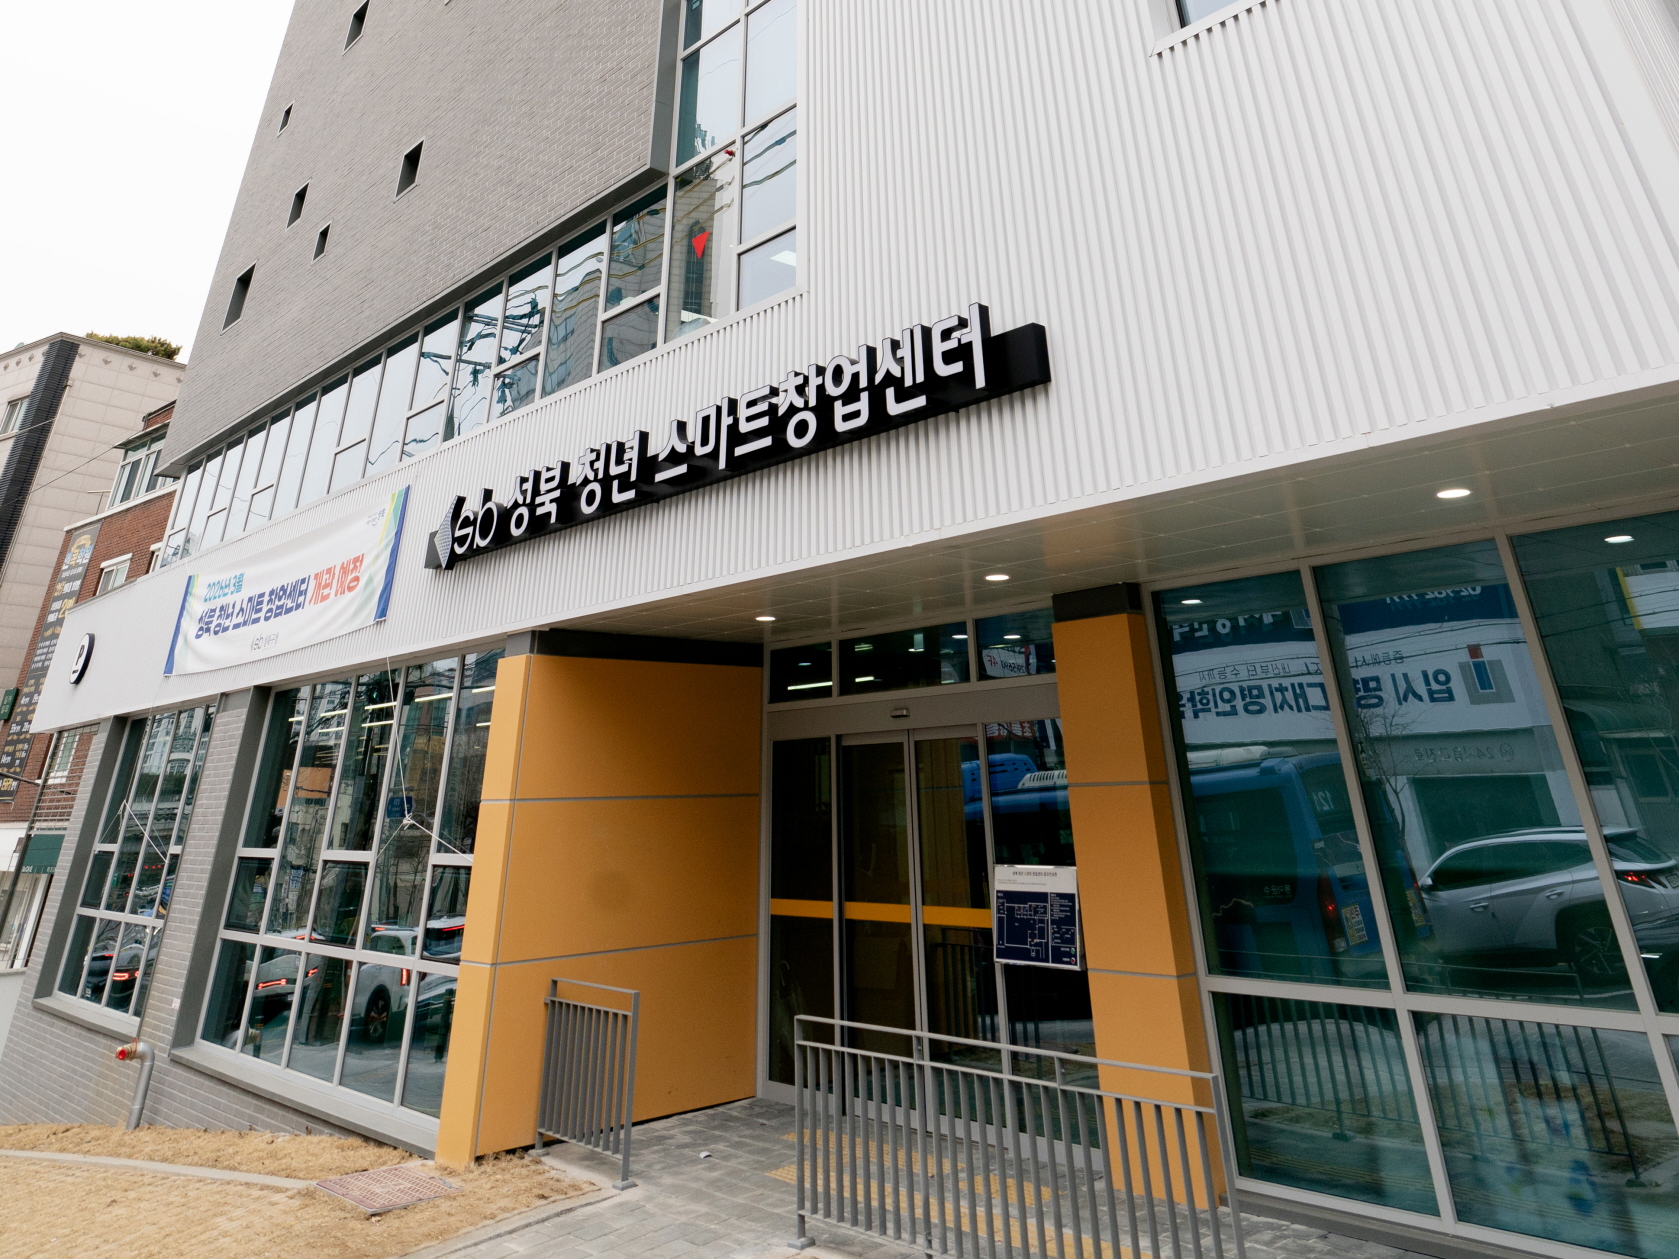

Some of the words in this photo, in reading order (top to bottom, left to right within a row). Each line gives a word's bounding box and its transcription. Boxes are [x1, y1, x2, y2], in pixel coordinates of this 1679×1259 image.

[506, 460, 571, 538] 성북
[574, 430, 650, 516] 청년
[195, 607, 217, 640] 성북
[213, 600, 237, 636] 청년
[231, 591, 268, 631] 스마트
[263, 575, 311, 622] 창업센터
[308, 564, 337, 606] 개관
[335, 552, 365, 598] 예정
[229, 572, 246, 595] 3월
